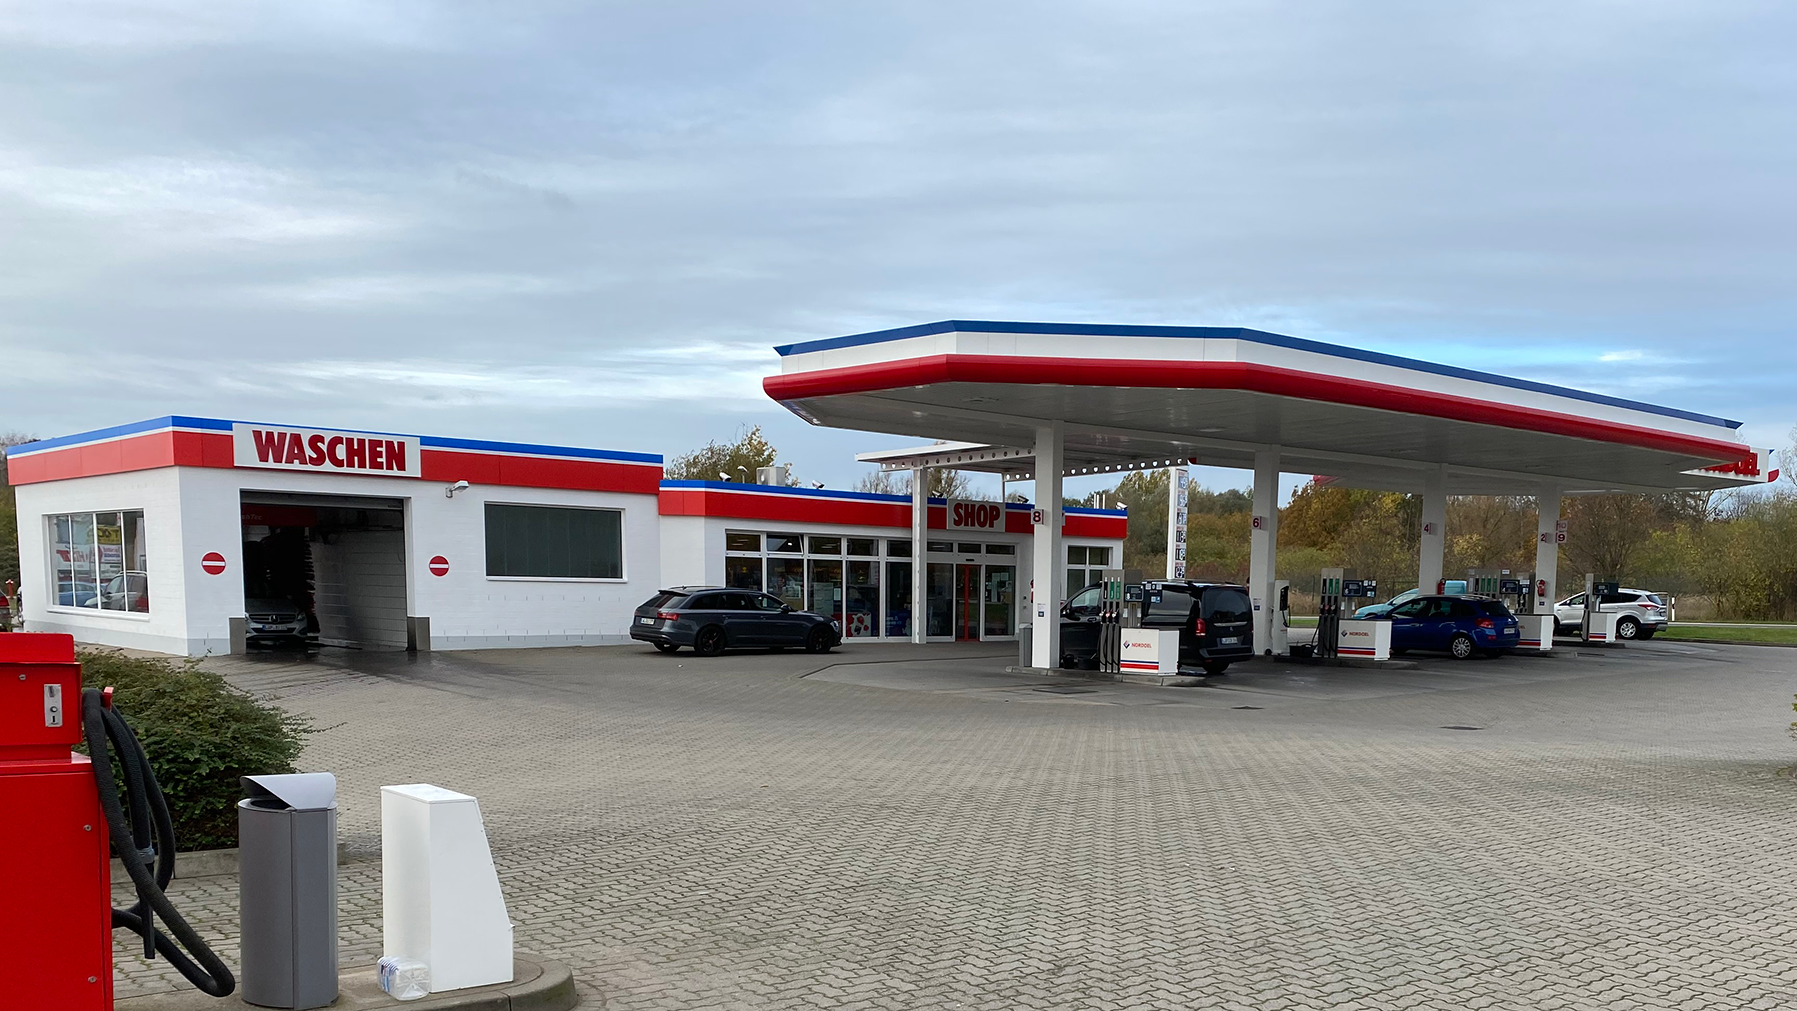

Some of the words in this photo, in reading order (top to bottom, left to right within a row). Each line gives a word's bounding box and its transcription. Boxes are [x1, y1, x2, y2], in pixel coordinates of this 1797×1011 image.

[252, 429, 406, 472] WASCHEN
[953, 502, 1001, 528] SHOP
[1033, 511, 1041, 522] 8
[1253, 517, 1260, 528] 6
[1424, 524, 1429, 532] 4
[1540, 534, 1546, 542] 2
[1558, 534, 1565, 542] 9
